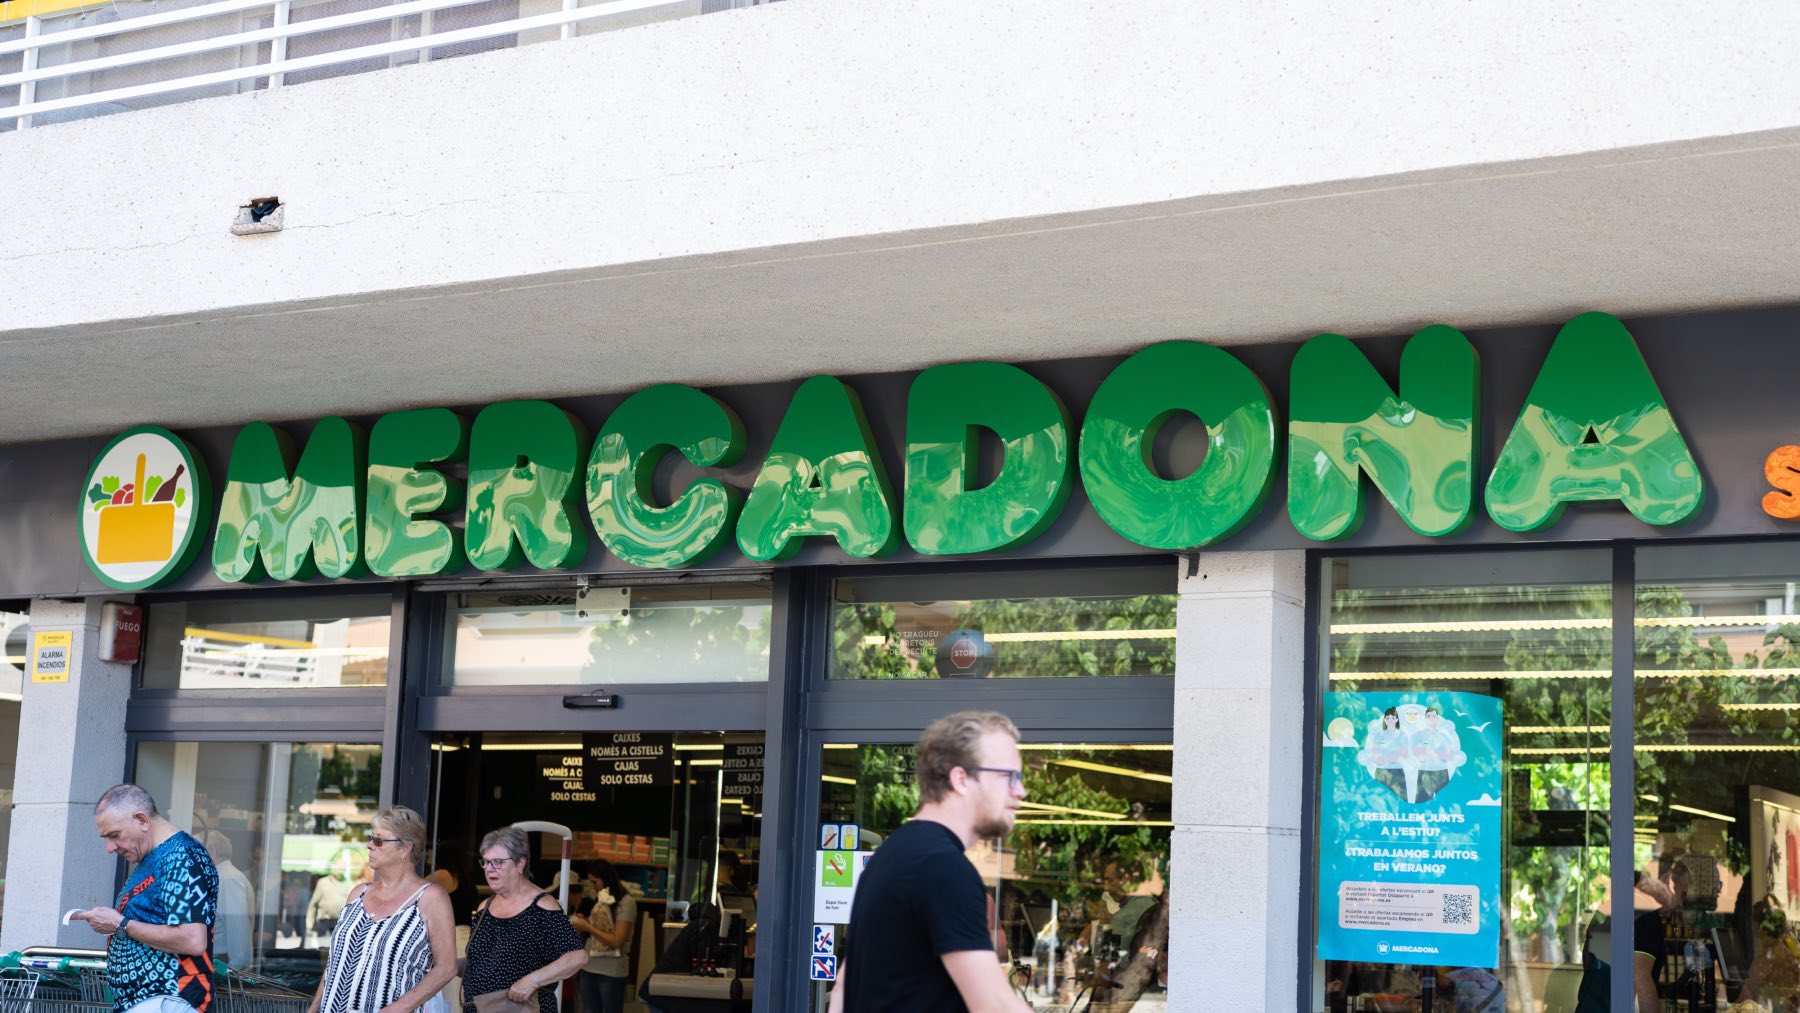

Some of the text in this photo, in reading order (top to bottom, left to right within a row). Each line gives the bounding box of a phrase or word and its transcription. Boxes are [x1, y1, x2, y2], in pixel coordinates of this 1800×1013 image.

[212, 311, 1704, 583] MERCADONA
[115, 620, 140, 633] FUEGO
[903, 630, 939, 639] TRAGUEU
[41, 651, 64, 659] ALARMA
[37, 660, 66, 669] INCENDIOS
[613, 733, 641, 743] CAIXES
[621, 747, 628, 756] A
[629, 745, 664, 756] CISTELLS
[562, 757, 583, 767] CAIXE
[614, 761, 639, 772] CAJAS
[569, 768, 576, 777] A
[601, 774, 653, 785] SOLO CESTAS
[551, 792, 596, 801] SOLO CESTAS
[1357, 812, 1465, 824] TREBALLEM JUNTS
[1381, 826, 1441, 837] A L'ESTIU?
[1344, 847, 1479, 861] ¿TRABAJAMOS JUNTOS
[1373, 862, 1447, 874] EN VERANO?
[1392, 945, 1440, 954] MERCADONA
